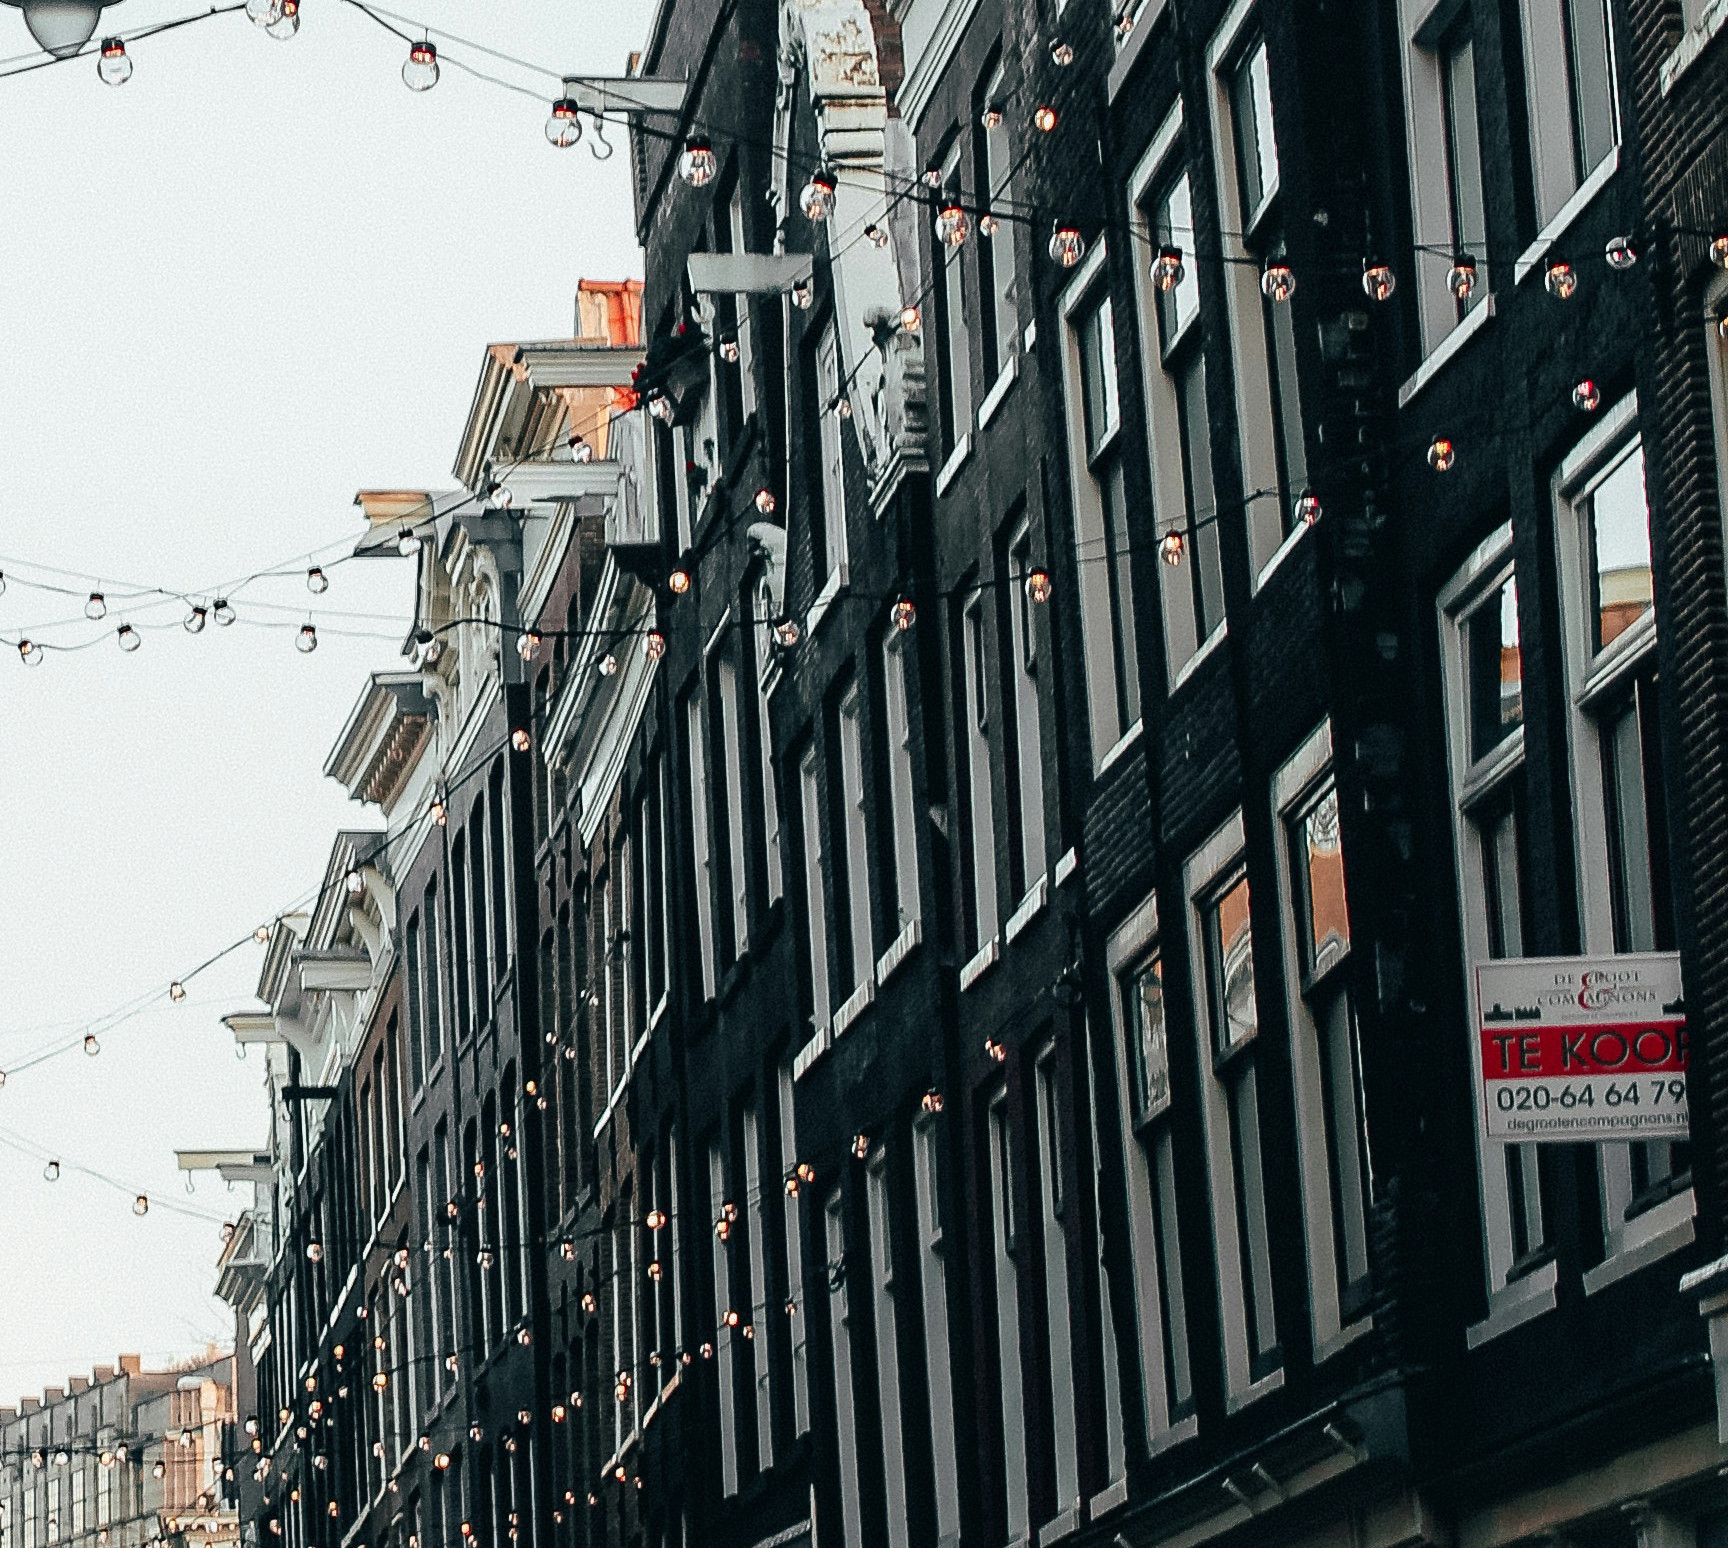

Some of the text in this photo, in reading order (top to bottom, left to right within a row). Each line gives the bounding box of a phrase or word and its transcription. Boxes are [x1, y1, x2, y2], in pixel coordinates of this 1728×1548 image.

[1492, 1033, 1542, 1072] TE
[1496, 1079, 1685, 1112] 020-64 64 79
